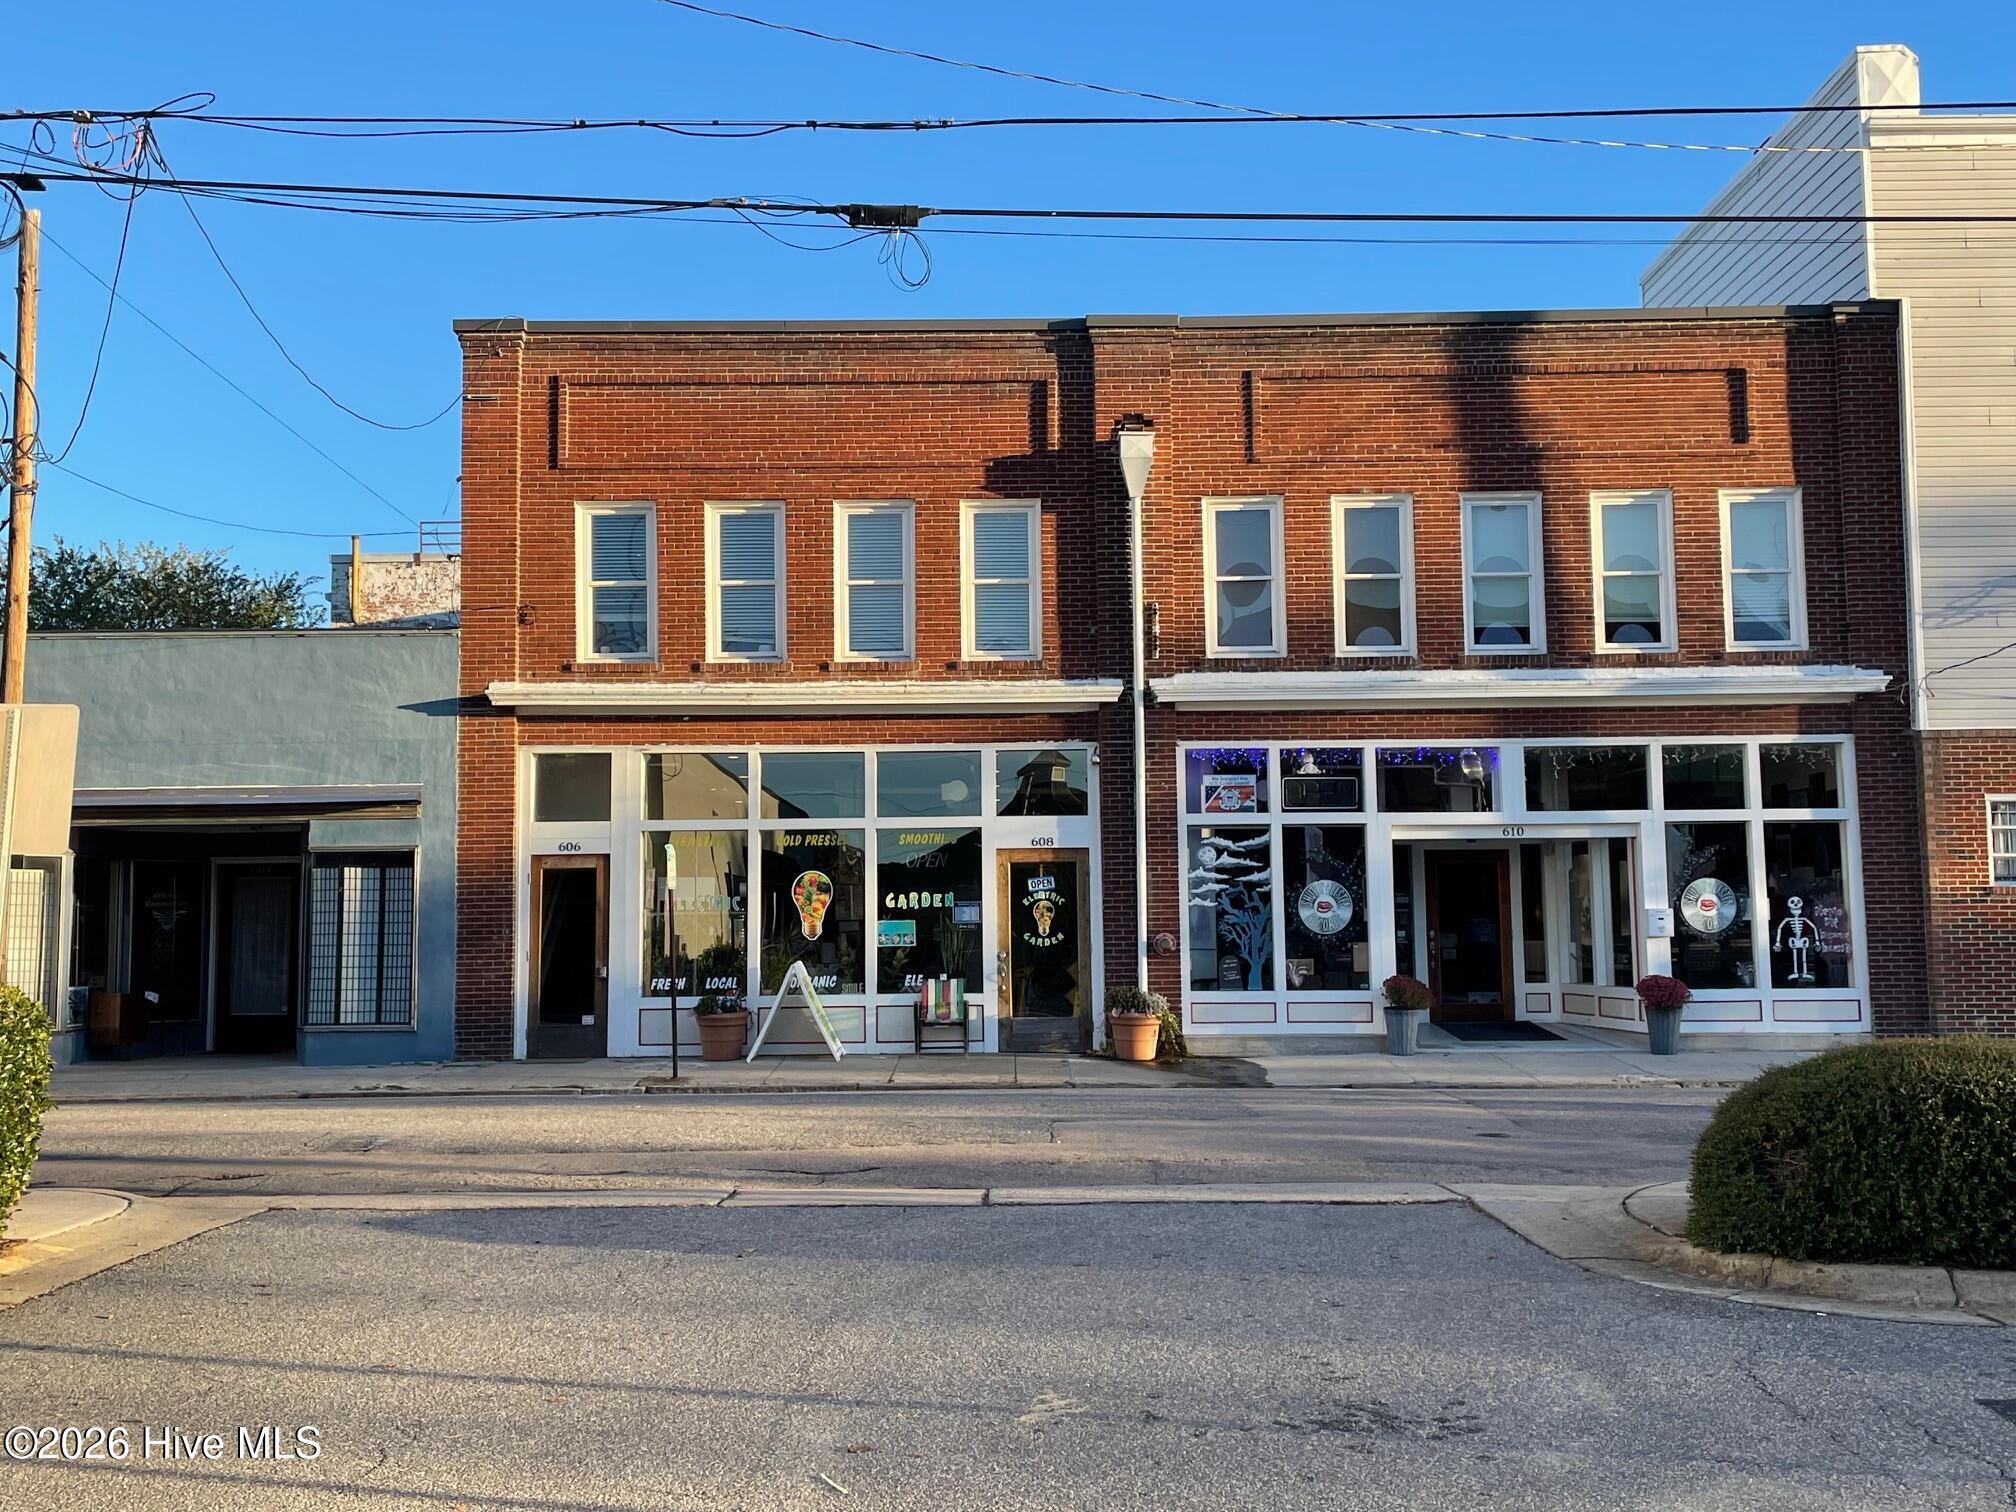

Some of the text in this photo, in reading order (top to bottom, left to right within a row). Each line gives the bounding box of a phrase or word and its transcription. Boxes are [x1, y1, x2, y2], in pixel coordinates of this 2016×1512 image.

[1502, 826, 1524, 837] 610
[776, 834, 848, 847] COLD PRESSE
[898, 833, 957, 845] SMOOTHIS
[1031, 837, 1054, 847] 608
[559, 841, 581, 851] 606
[906, 851, 949, 869] OPEN
[1030, 879, 1053, 889] OPEN
[676, 894, 741, 912] LECTRIC
[885, 892, 954, 910] GARDEN
[1023, 932, 1065, 947] GARDEN
[651, 977, 686, 990] FREH
[705, 977, 738, 989] LOCAL
[790, 975, 837, 988] OANIC
[841, 982, 865, 994] SMILE
